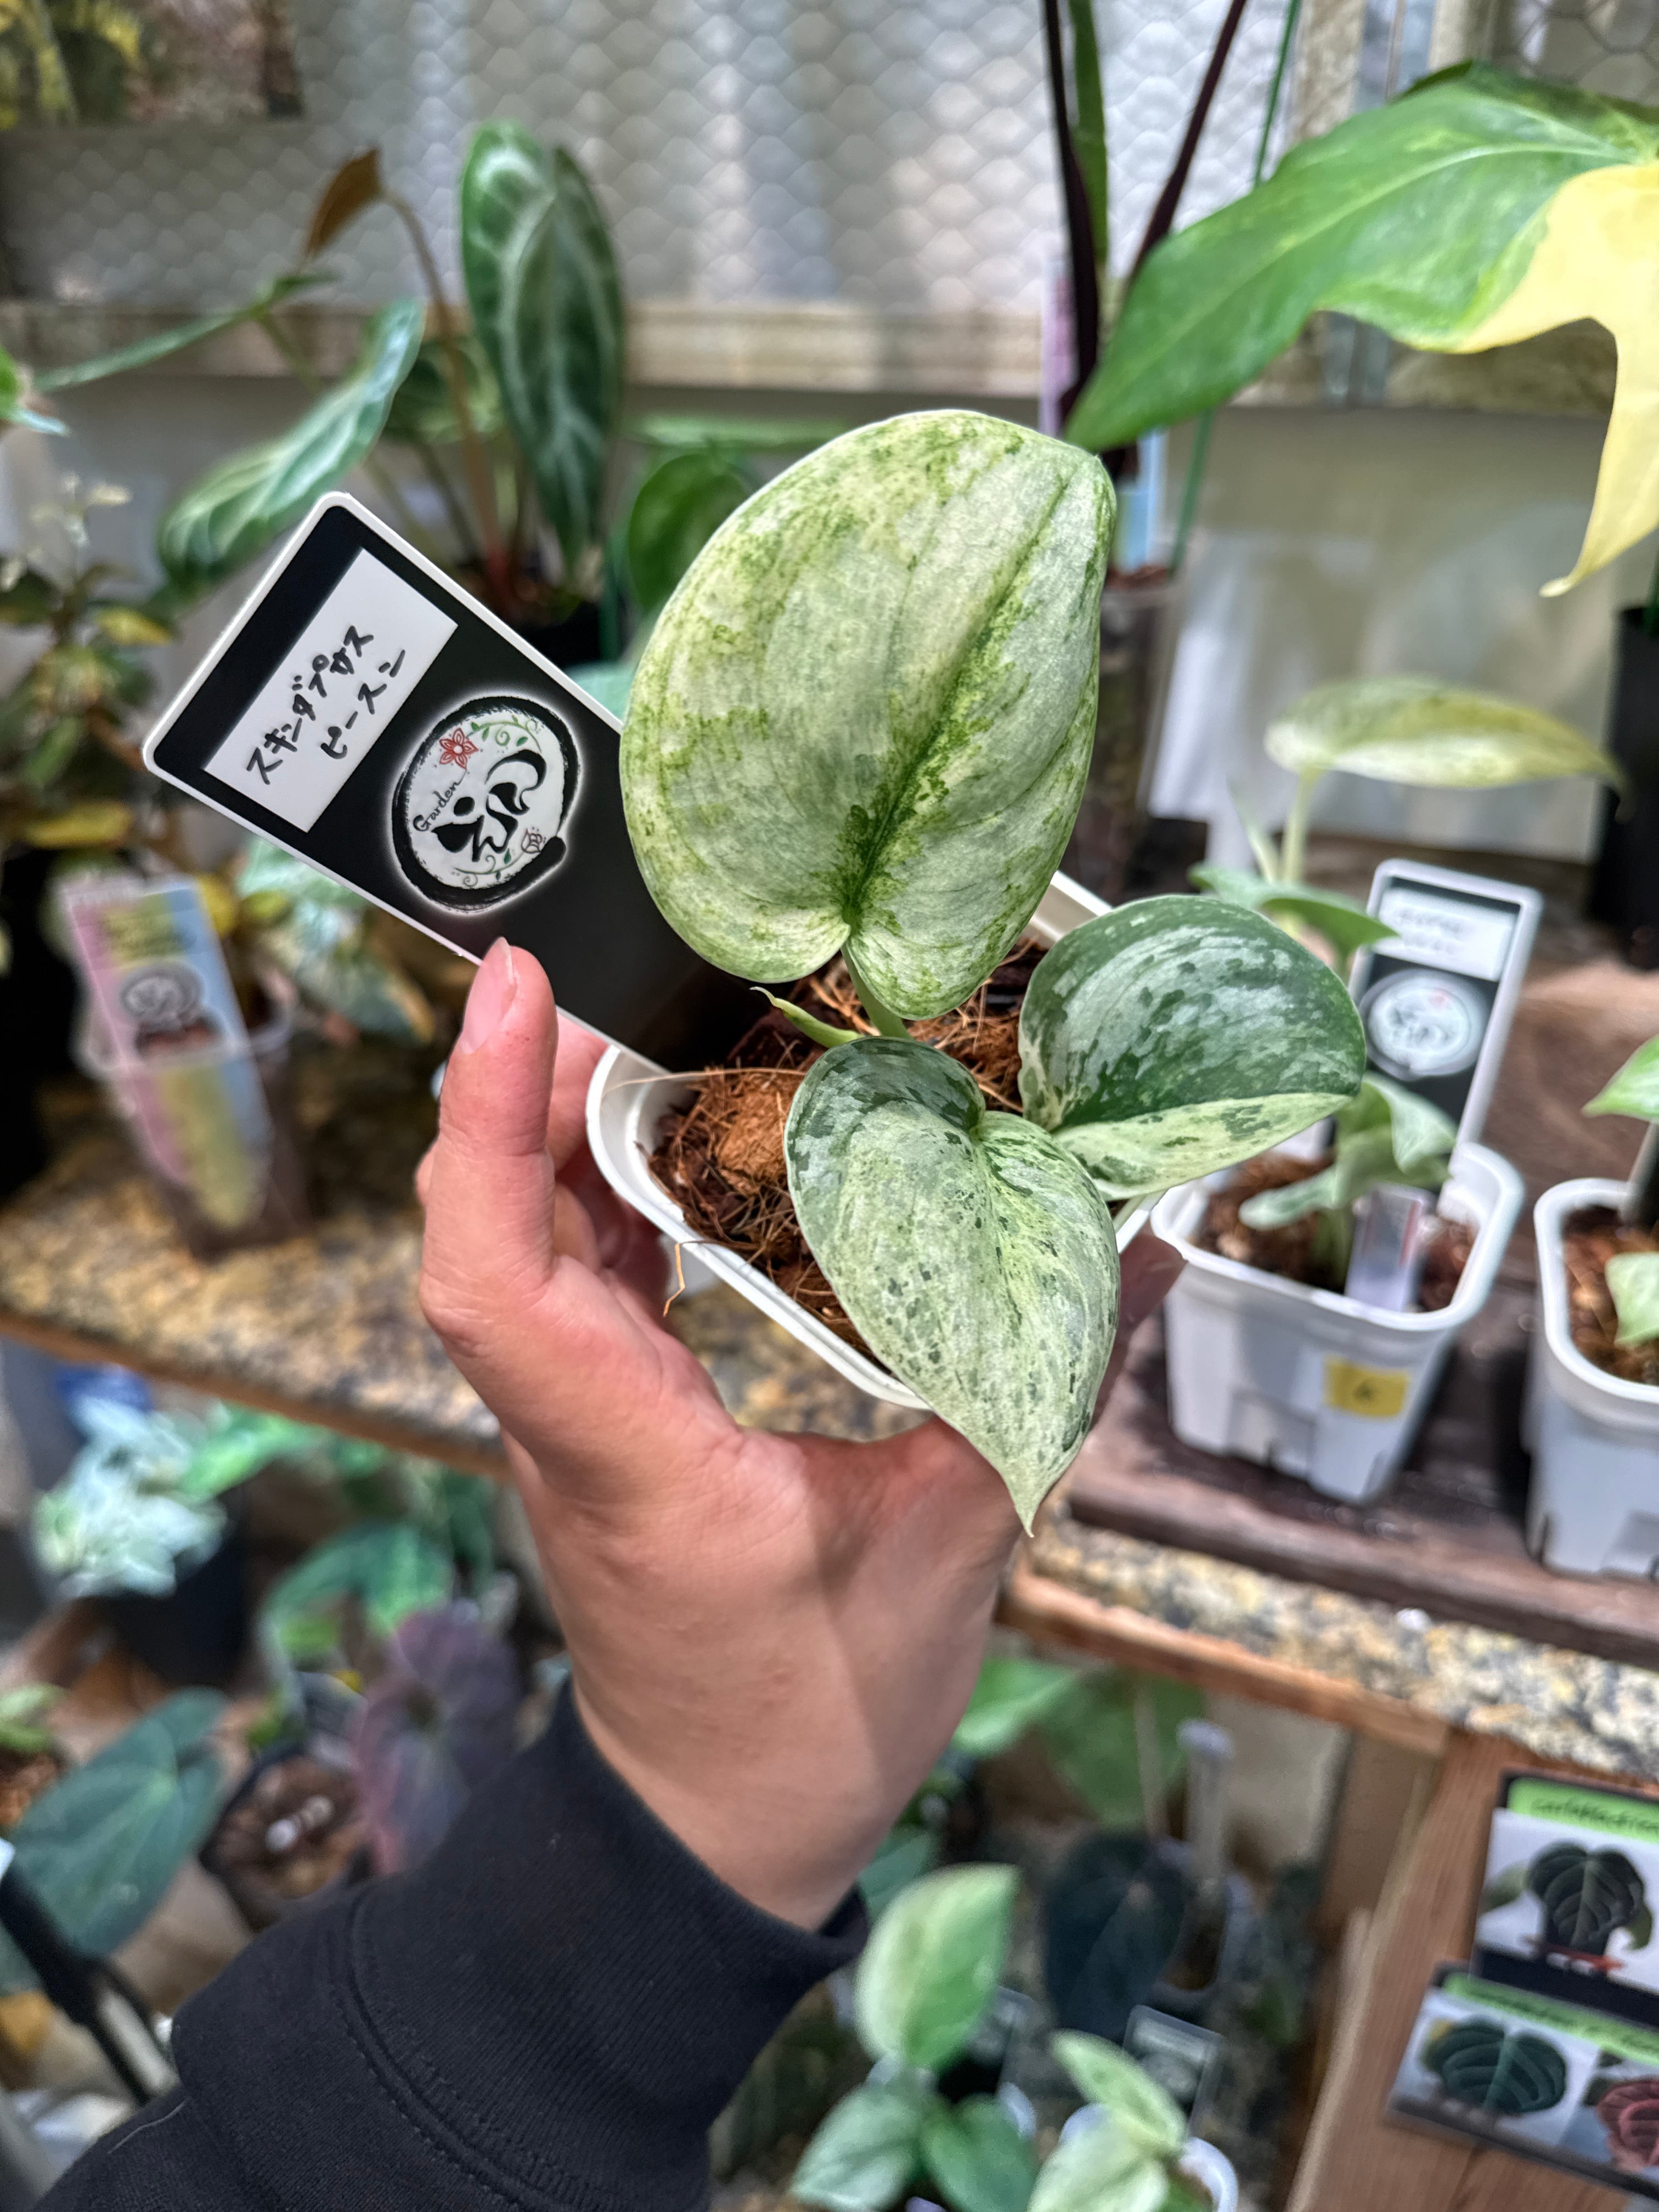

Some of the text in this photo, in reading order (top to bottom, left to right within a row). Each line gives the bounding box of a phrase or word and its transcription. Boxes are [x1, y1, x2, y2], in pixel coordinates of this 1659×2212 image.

[245, 625, 375, 786] スキンダプサス
[412, 774, 464, 833] Garden
